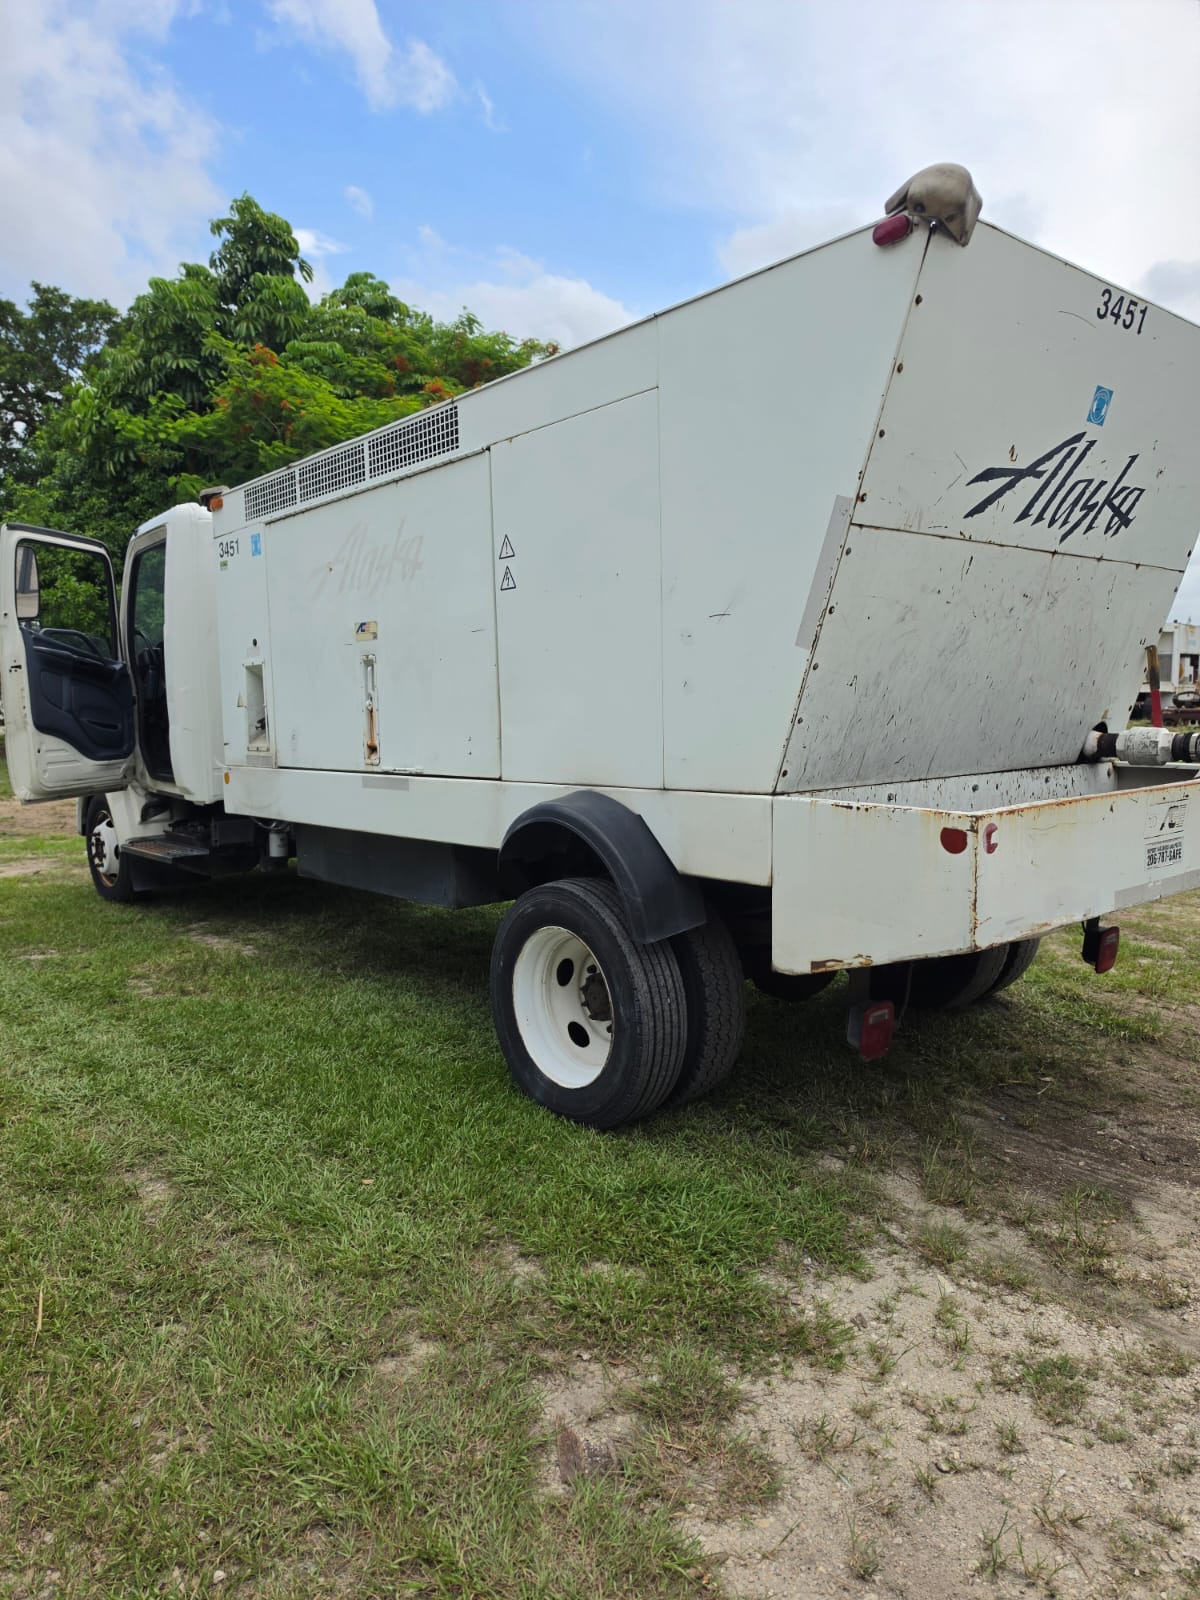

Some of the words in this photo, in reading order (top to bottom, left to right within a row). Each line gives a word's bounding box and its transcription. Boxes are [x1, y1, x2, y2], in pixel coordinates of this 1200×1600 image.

[1097, 288, 1148, 335] 3451
[963, 431, 1146, 545] Alaska
[219, 538, 239, 558] 3451
